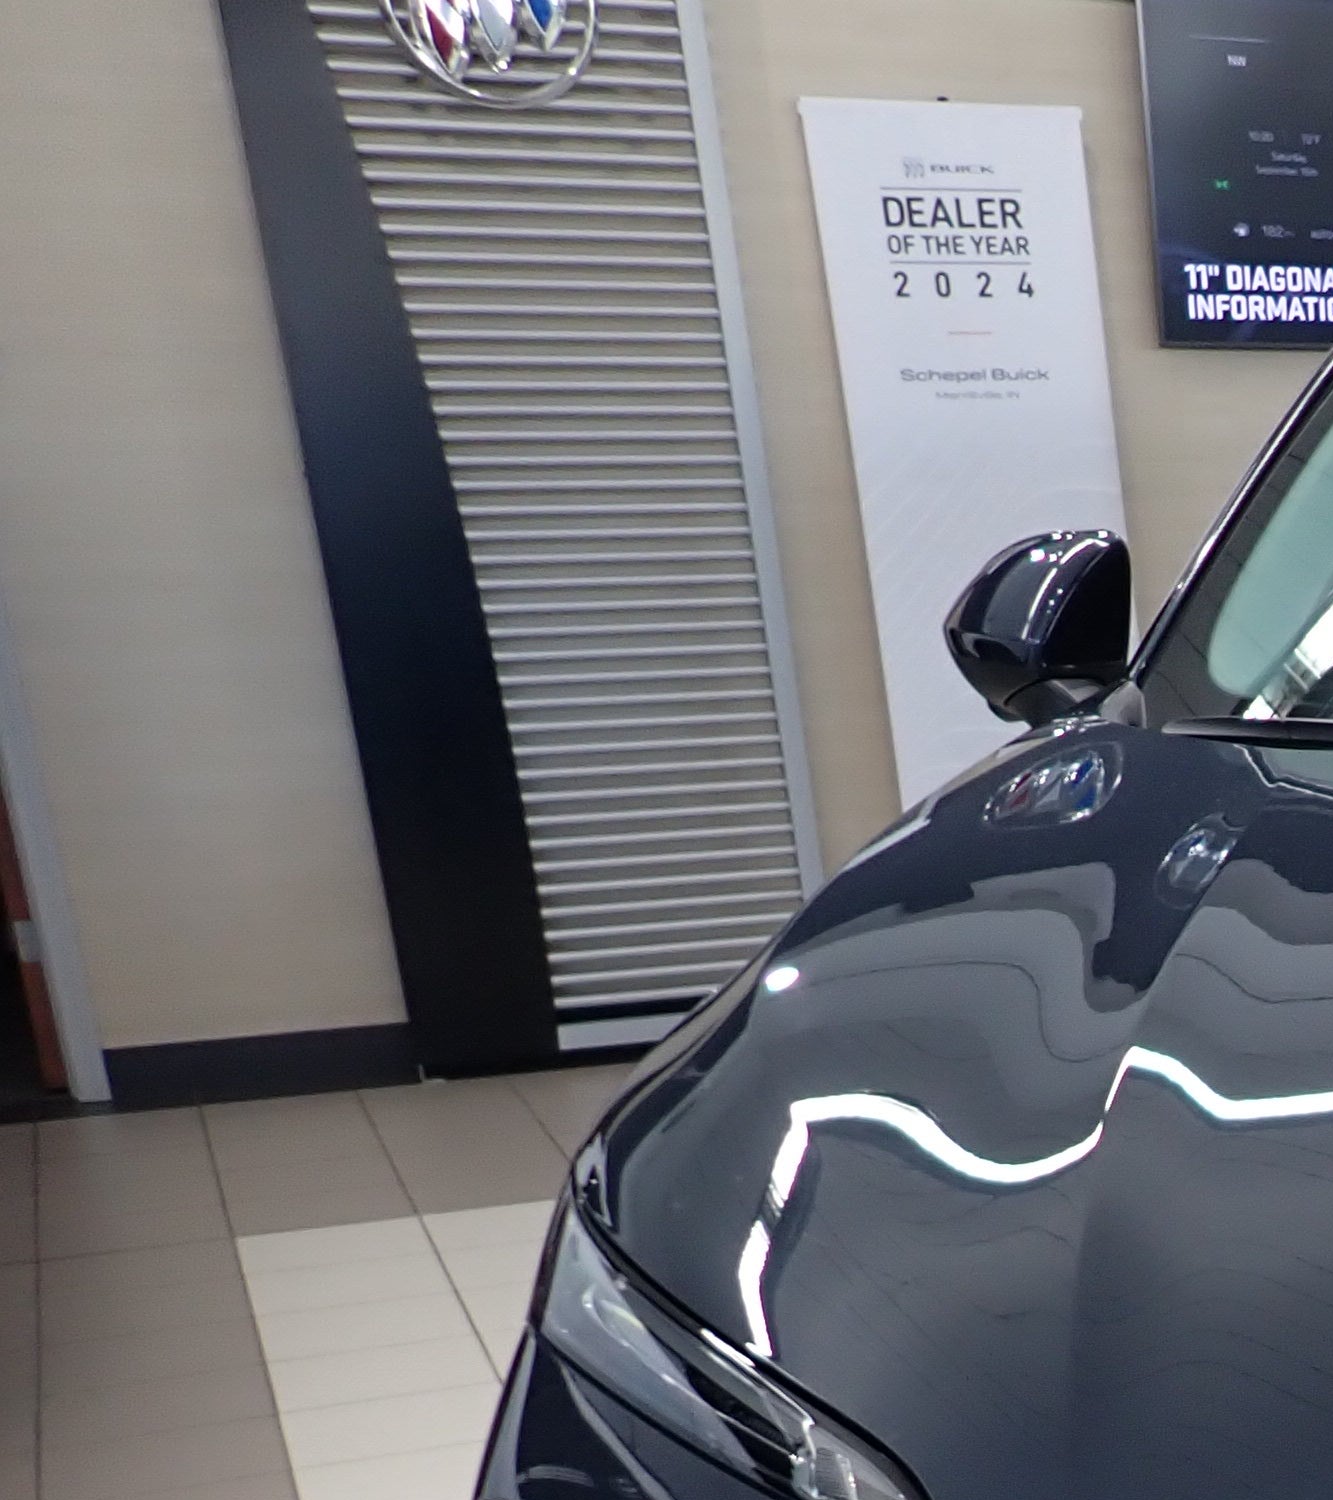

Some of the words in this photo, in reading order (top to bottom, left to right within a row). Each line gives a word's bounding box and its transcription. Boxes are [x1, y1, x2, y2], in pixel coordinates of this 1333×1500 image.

[882, 197, 1023, 229] DEALER
[887, 234, 915, 254] OF
[921, 235, 966, 255] THE
[970, 235, 1030, 255] YEAR
[900, 368, 987, 383] Schepel
[991, 367, 1050, 382] Buick
